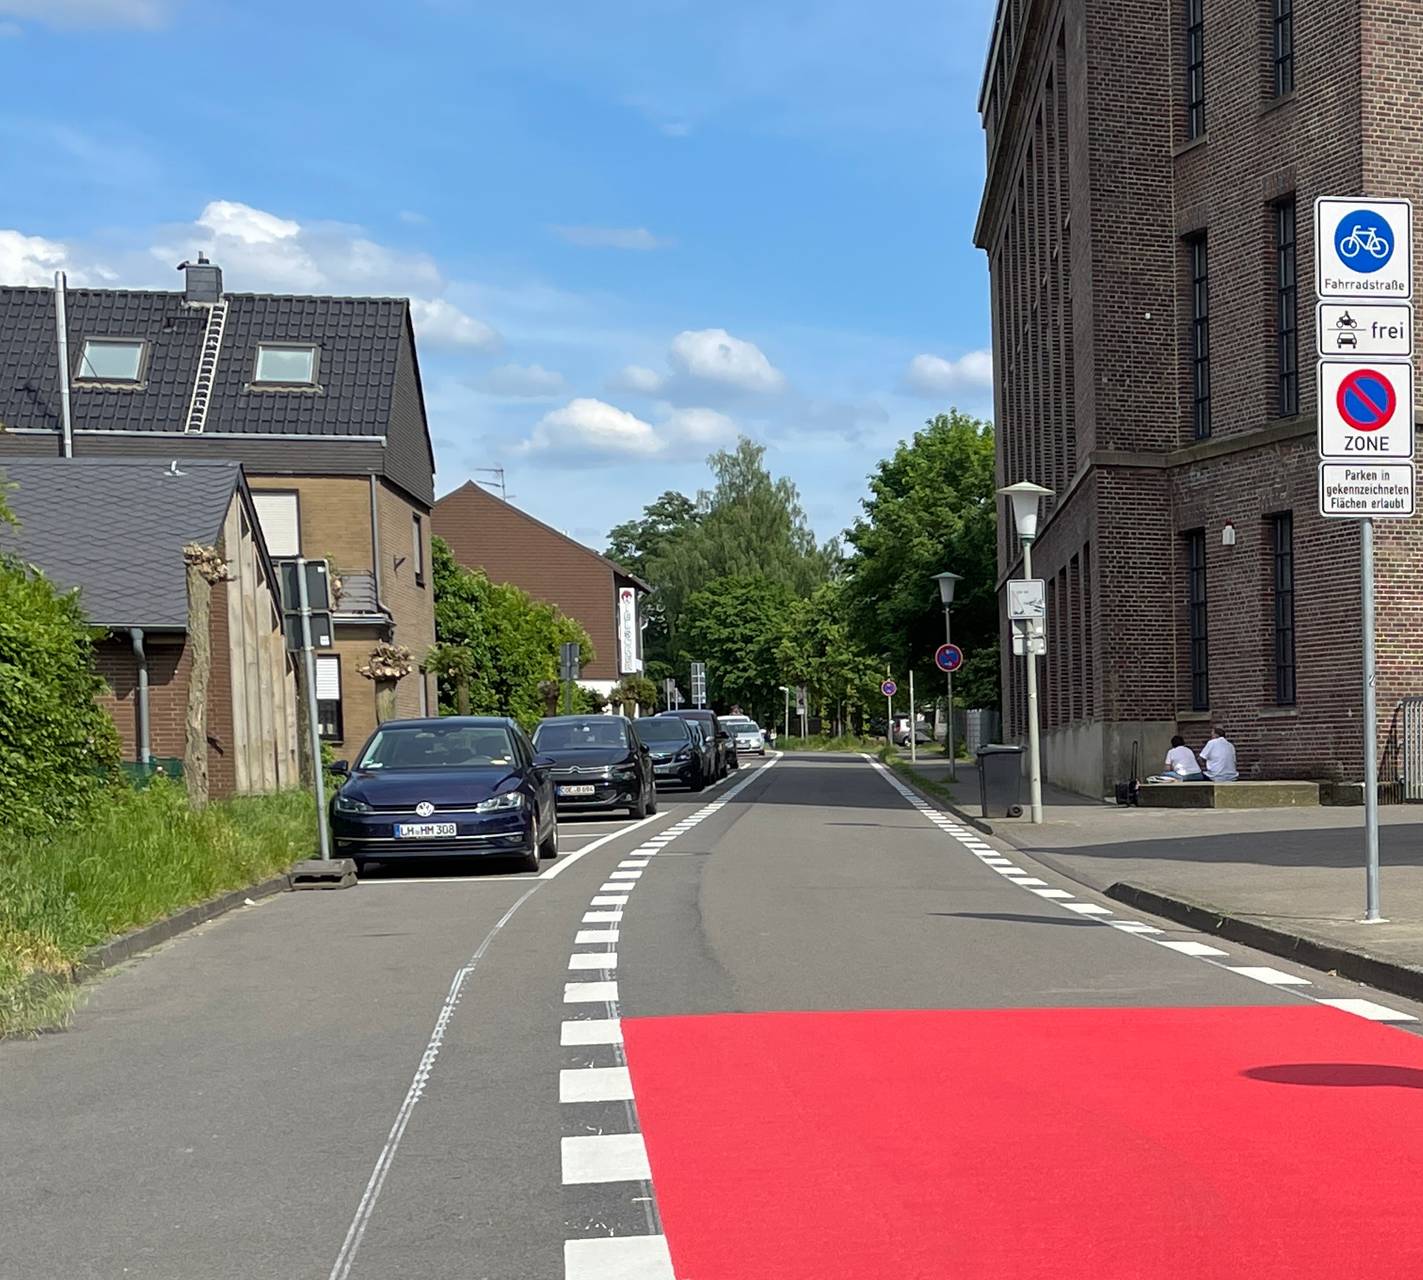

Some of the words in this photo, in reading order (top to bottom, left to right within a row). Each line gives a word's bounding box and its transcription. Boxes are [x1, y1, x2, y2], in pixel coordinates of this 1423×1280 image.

[1324, 278, 1405, 291] Fahrradstraße
[1371, 321, 1404, 339] frei
[1344, 435, 1390, 451] ZONE
[1345, 469, 1377, 481] Parken
[1381, 469, 1390, 481] in
[1326, 483, 1409, 497] gekennzeichneten
[1331, 497, 1367, 509] Flächen
[1371, 497, 1404, 509] erlaubt
[436, 824, 455, 835] 308
